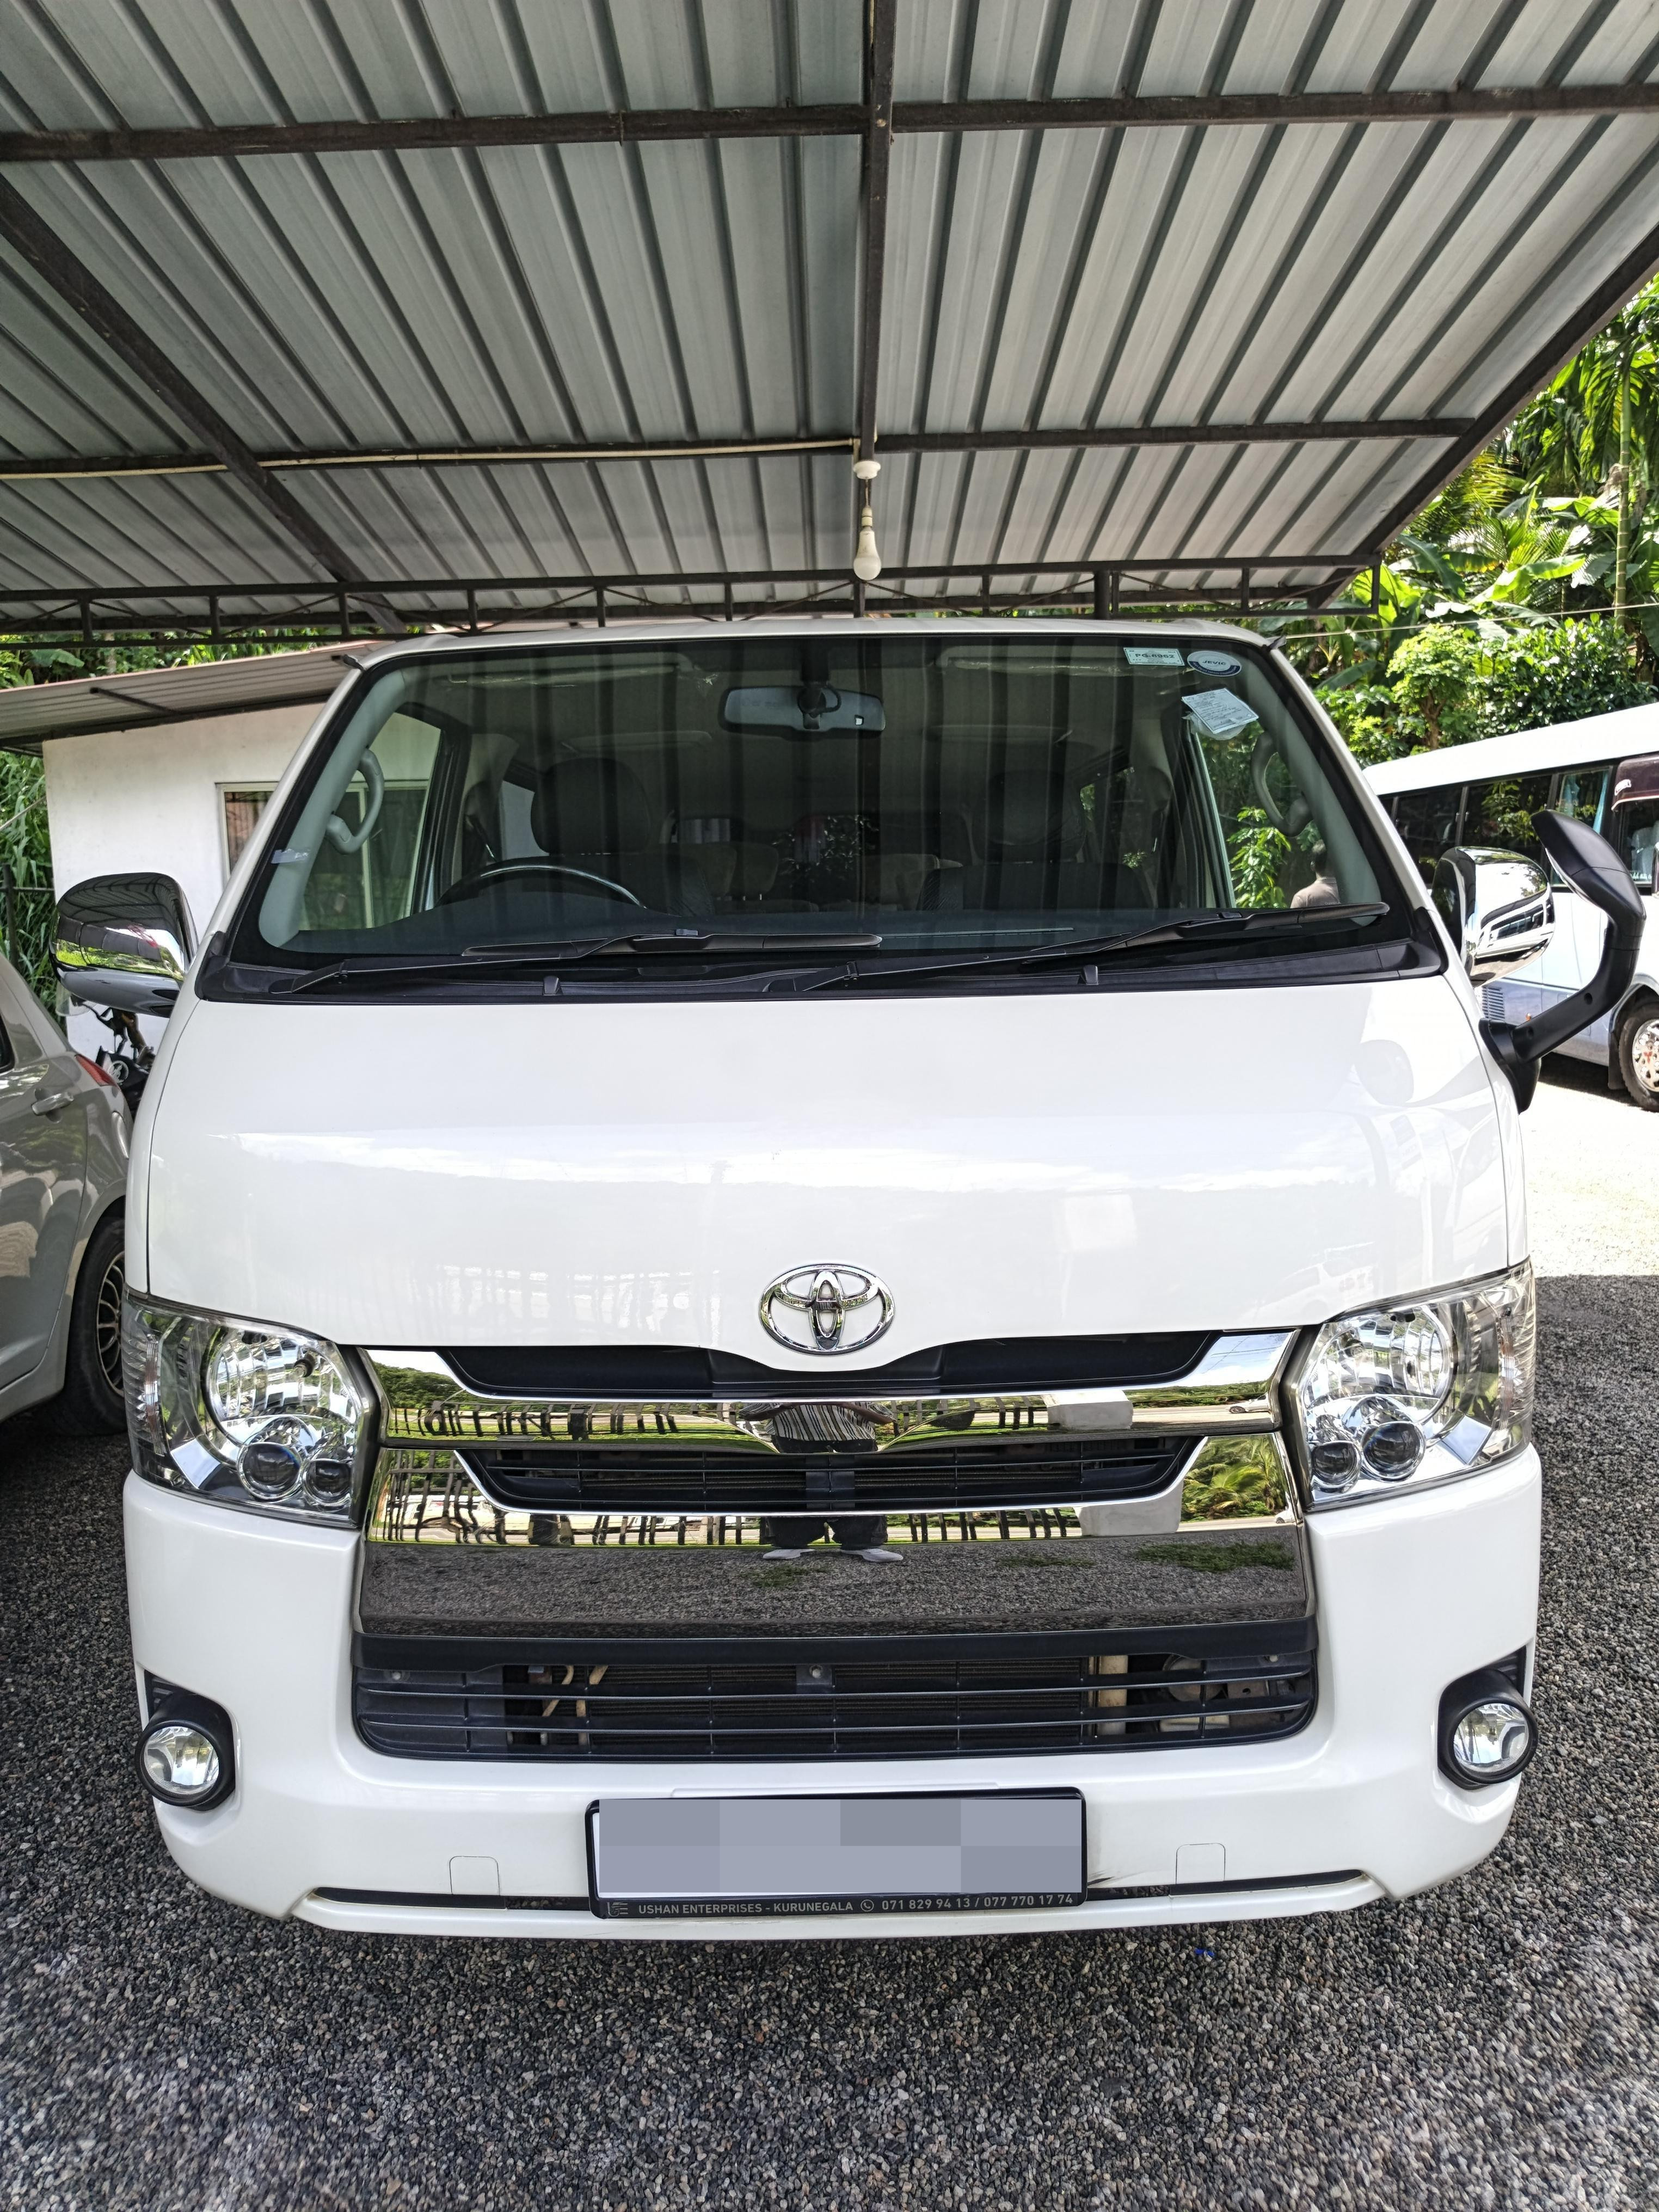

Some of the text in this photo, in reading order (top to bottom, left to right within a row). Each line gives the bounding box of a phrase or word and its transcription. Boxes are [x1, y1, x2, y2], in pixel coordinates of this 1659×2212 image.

[638, 1904, 679, 1914] USHAN
[683, 1903, 763, 1914] ENTERPRISES
[773, 1902, 853, 1913] KURUNEGALA
[882, 1900, 904, 1910] 071
[908, 1899, 932, 1909] 829
[936, 1898, 952, 1909] 94
[956, 1897, 970, 1908] 13
[984, 1896, 1007, 1907] 077
[1011, 1895, 1034, 1906] 770
[1039, 1894, 1053, 1905] 17
[1058, 1894, 1073, 1904] 74
